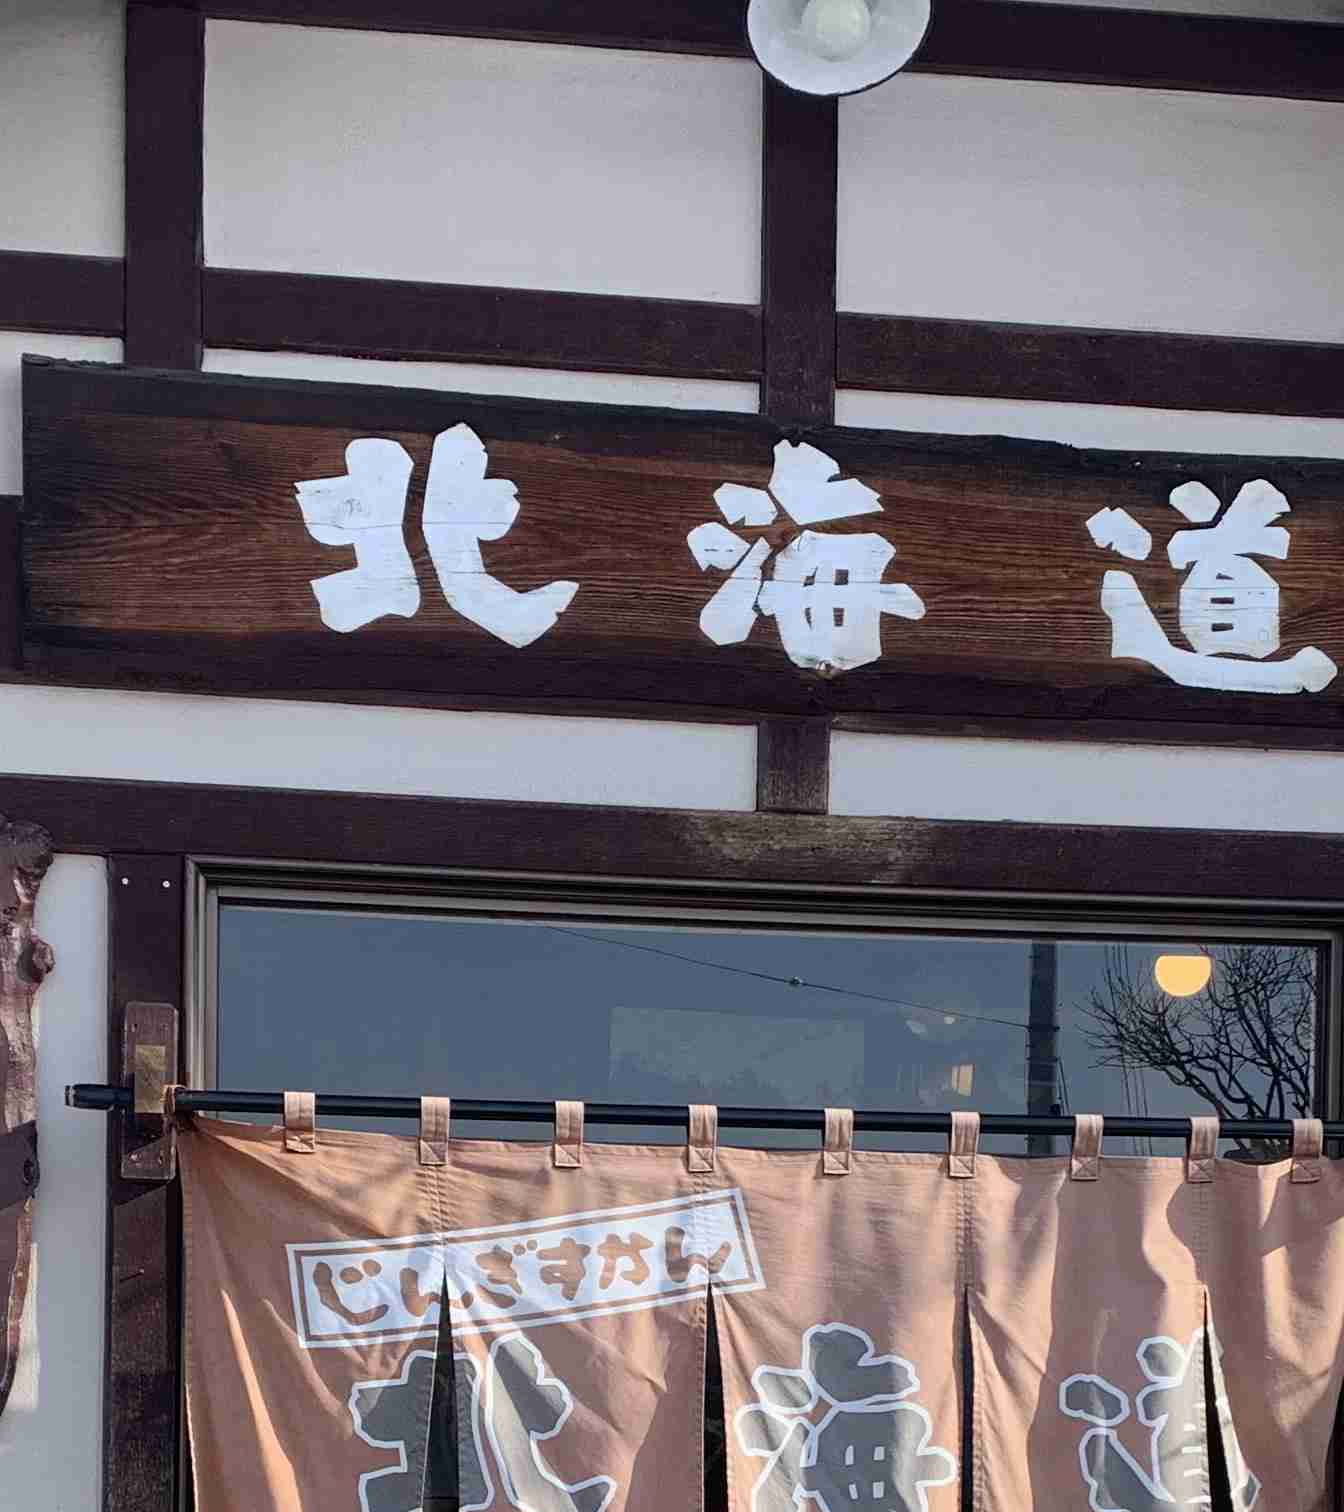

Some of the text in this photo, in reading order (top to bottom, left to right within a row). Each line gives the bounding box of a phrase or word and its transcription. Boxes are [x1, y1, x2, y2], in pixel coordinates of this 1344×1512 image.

[293, 422, 1338, 693] 北海道
[312, 1224, 732, 1326] じんぎすかん
